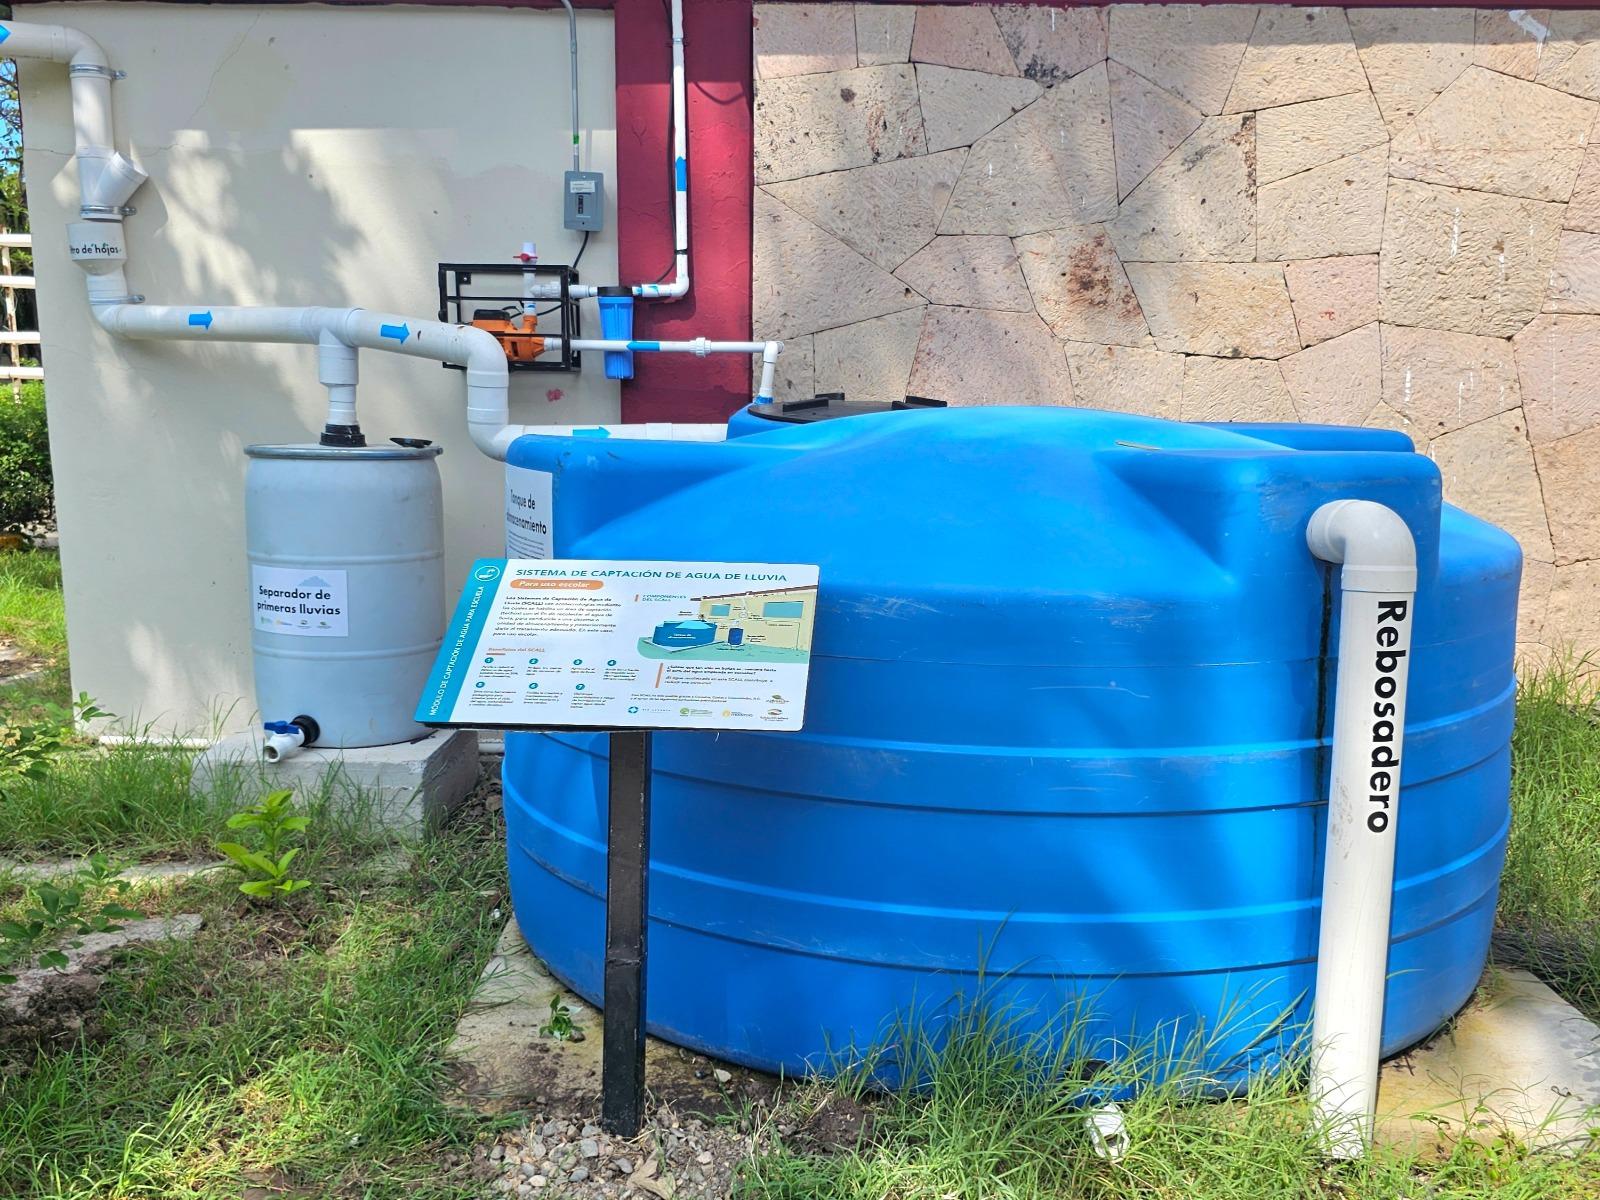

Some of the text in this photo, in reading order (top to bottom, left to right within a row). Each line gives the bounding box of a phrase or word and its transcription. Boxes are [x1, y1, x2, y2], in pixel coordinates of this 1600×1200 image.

[81, 244, 93, 254] de
[527, 493, 536, 510] de
[516, 569, 567, 577] SISTEMA
[590, 570, 662, 578] CAPTACIÓN
[665, 571, 682, 579] DE
[684, 572, 721, 580] AGUA
[744, 574, 788, 582] LLUVIA
[518, 580, 539, 588] Para
[258, 585, 331, 600] Separador de
[257, 600, 341, 615] primeras lluvias
[1367, 600, 1408, 833] Rebosadero
